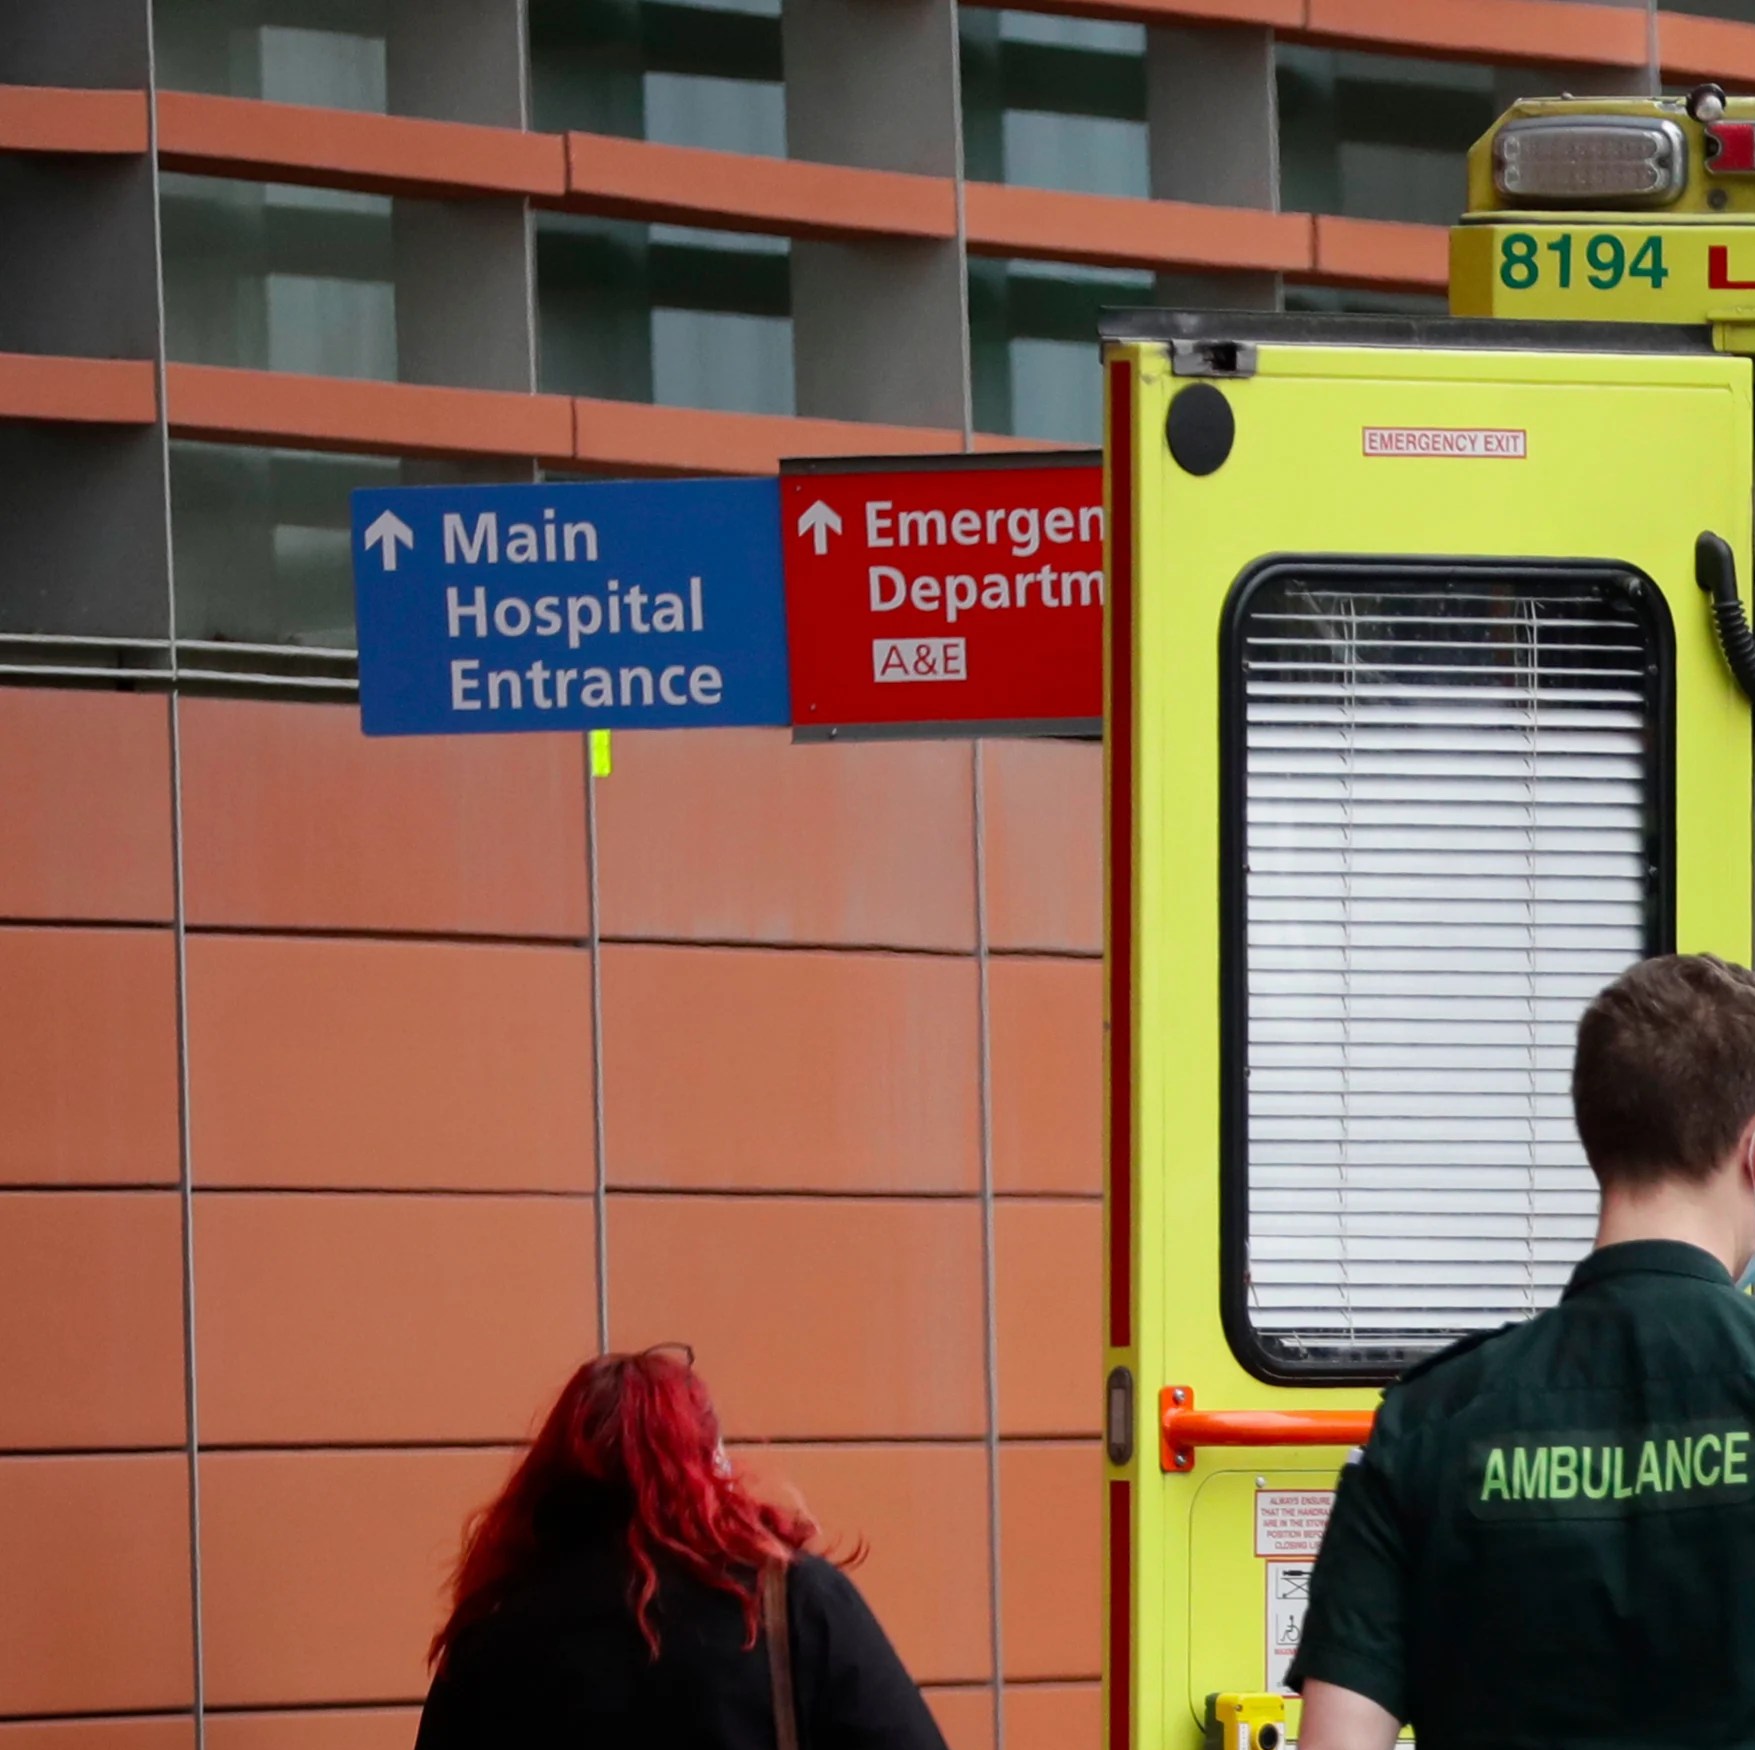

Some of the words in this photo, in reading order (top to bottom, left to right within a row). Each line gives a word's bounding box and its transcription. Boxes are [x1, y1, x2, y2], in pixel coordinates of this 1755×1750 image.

[1500, 233, 1669, 291] 8194
[1368, 432, 1478, 452] EMERGENCY
[1484, 434, 1520, 453] EXIT
[443, 508, 599, 566] Main
[866, 500, 1103, 557] Emergen
[446, 576, 705, 649] Hospital
[869, 565, 1103, 622] Departm
[451, 658, 723, 710] Entrance
[880, 642, 964, 678] A&E
[1480, 1431, 1751, 1502] AMBULANCE
[1297, 1508, 1330, 1516] HANDRA
